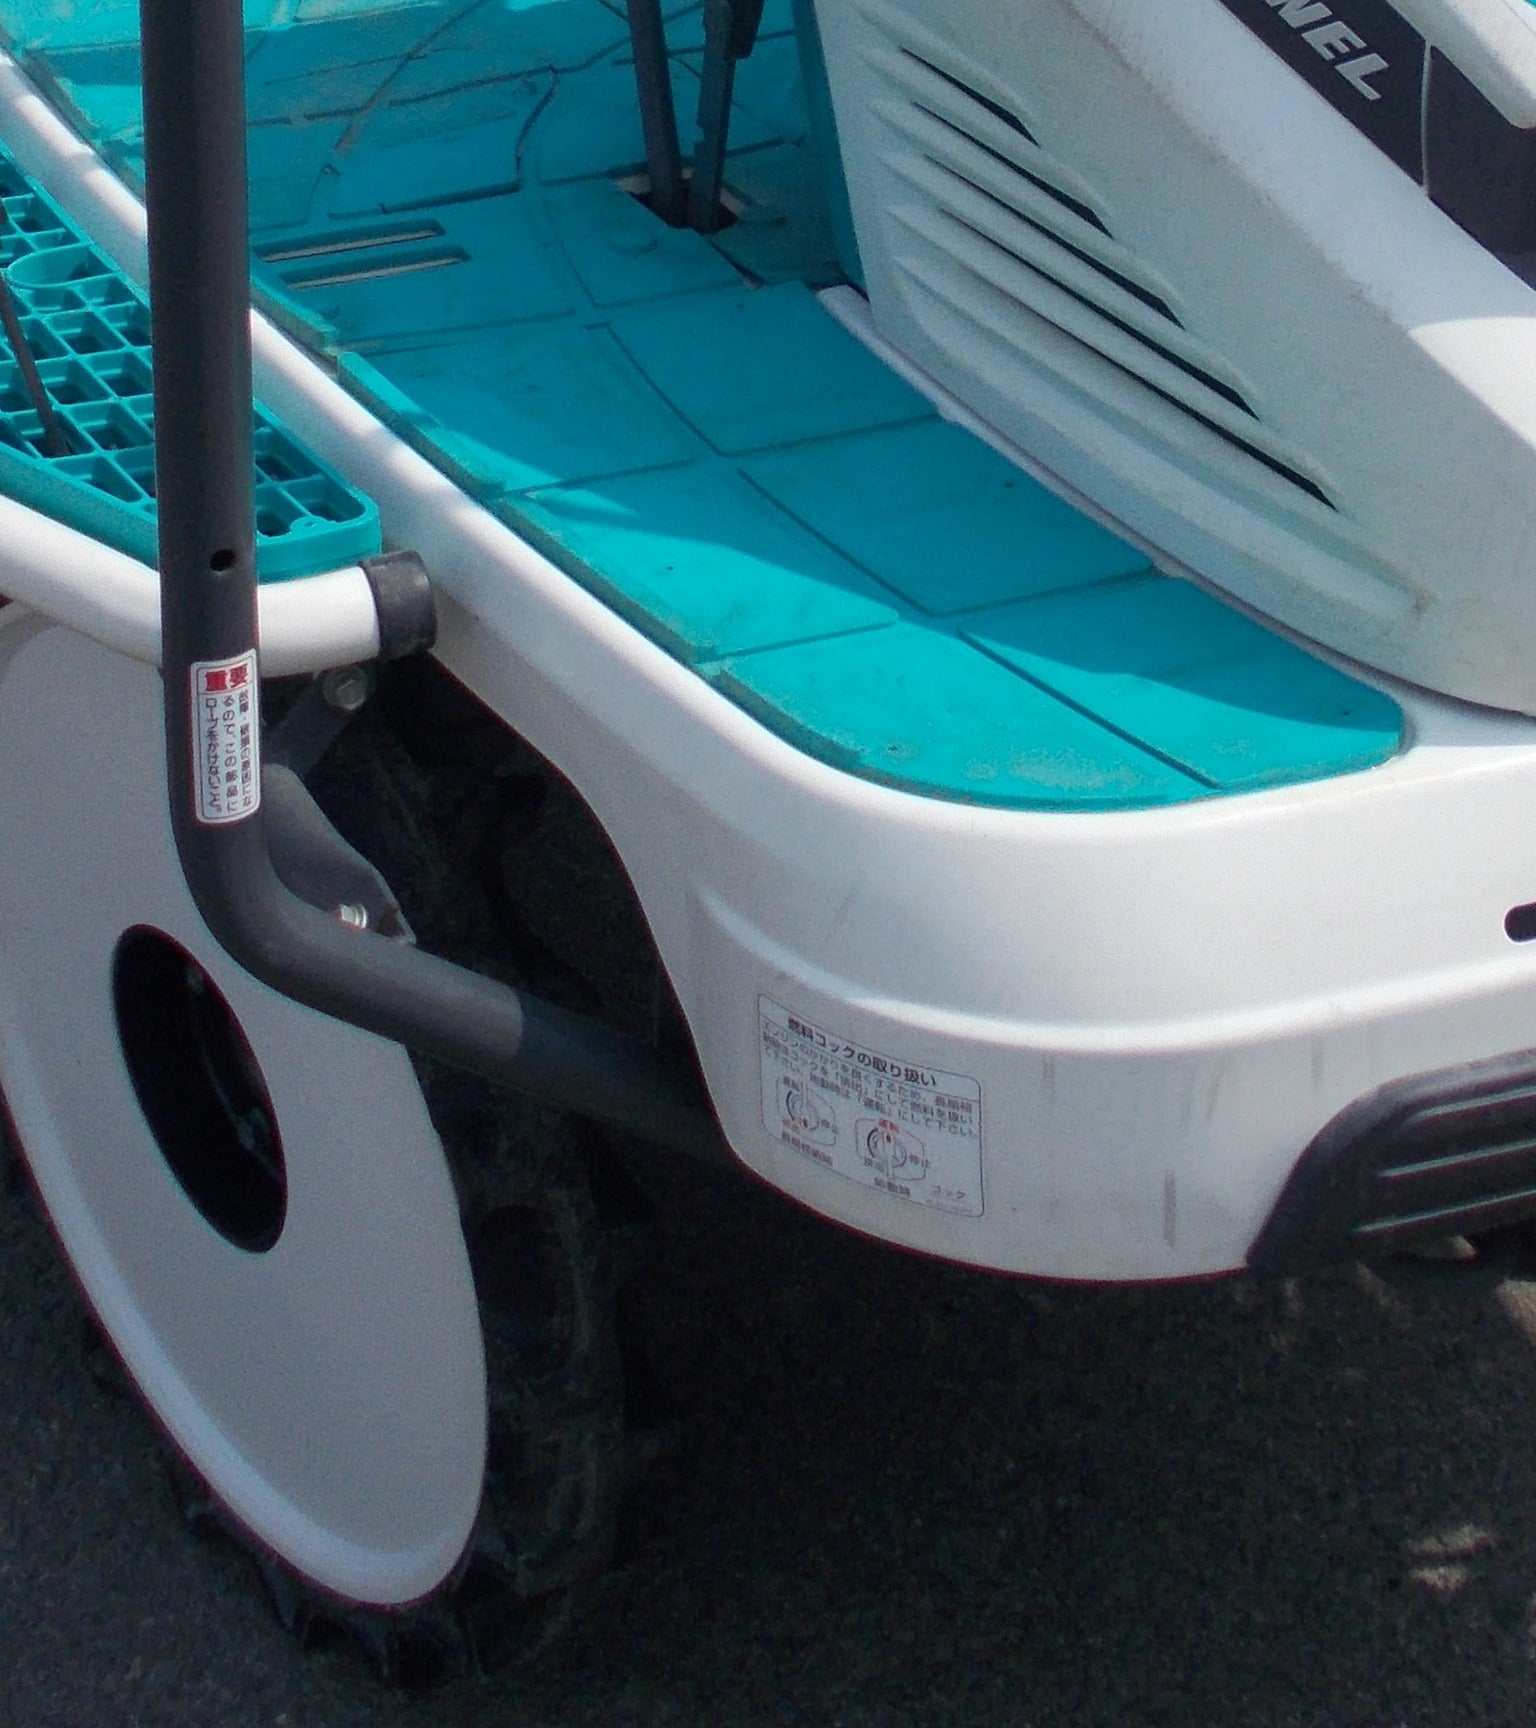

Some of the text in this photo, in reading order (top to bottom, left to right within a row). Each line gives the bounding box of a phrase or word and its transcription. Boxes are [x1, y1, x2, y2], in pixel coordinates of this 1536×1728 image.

[205, 663, 249, 692] 重要
[787, 1016, 937, 1087] 燃料コックの取り扱い
